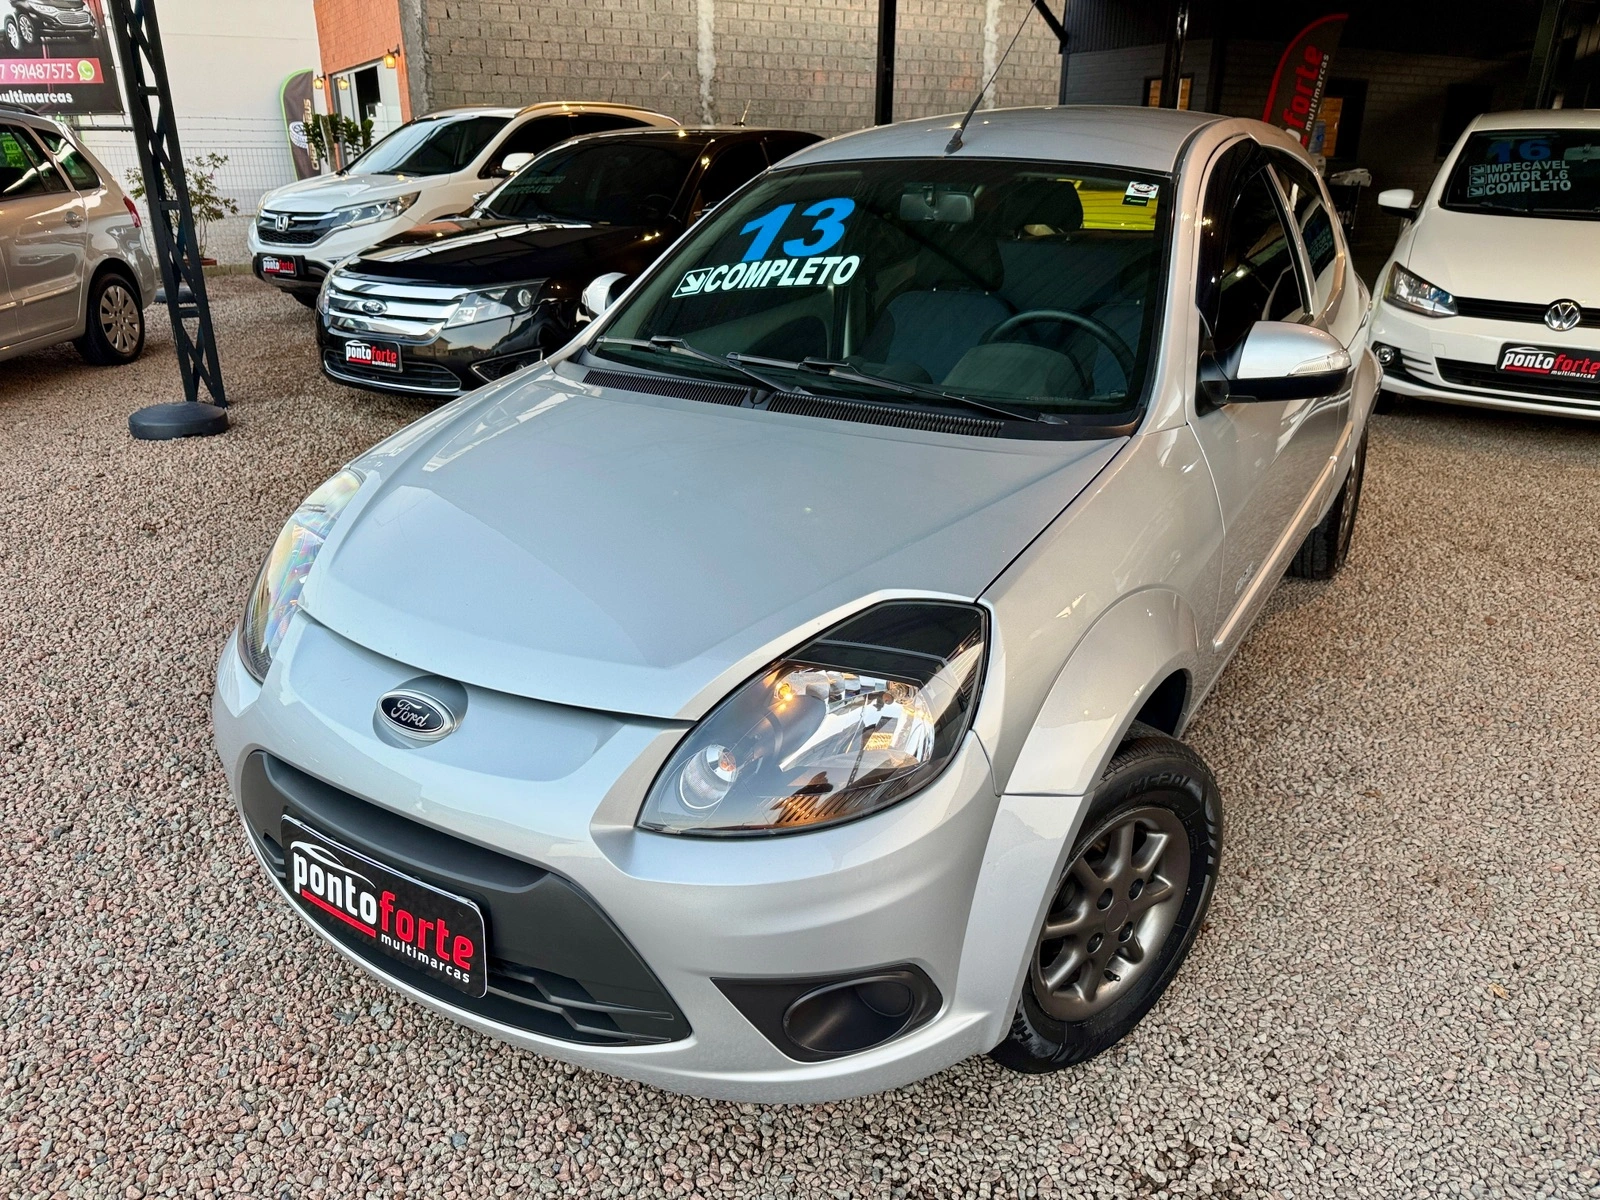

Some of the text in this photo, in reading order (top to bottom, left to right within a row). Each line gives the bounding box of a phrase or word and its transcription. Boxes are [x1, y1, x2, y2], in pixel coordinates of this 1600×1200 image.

[10, 63, 75, 79] 991487575
[0, 89, 74, 103] ultimarcas
[1305, 53, 1330, 132] multimarcas
[1486, 140, 1551, 163] 16
[1486, 160, 1570, 174] IMPECÁVEL
[1487, 169, 1568, 183] MOTOR 1.6
[1485, 180, 1572, 195] COMPLETO
[739, 197, 856, 263] 13
[703, 255, 861, 293] COMPLETO
[1550, 370, 1596, 379] multimarcas
[390, 699, 431, 728] Ford
[380, 932, 471, 984] multimarcas
